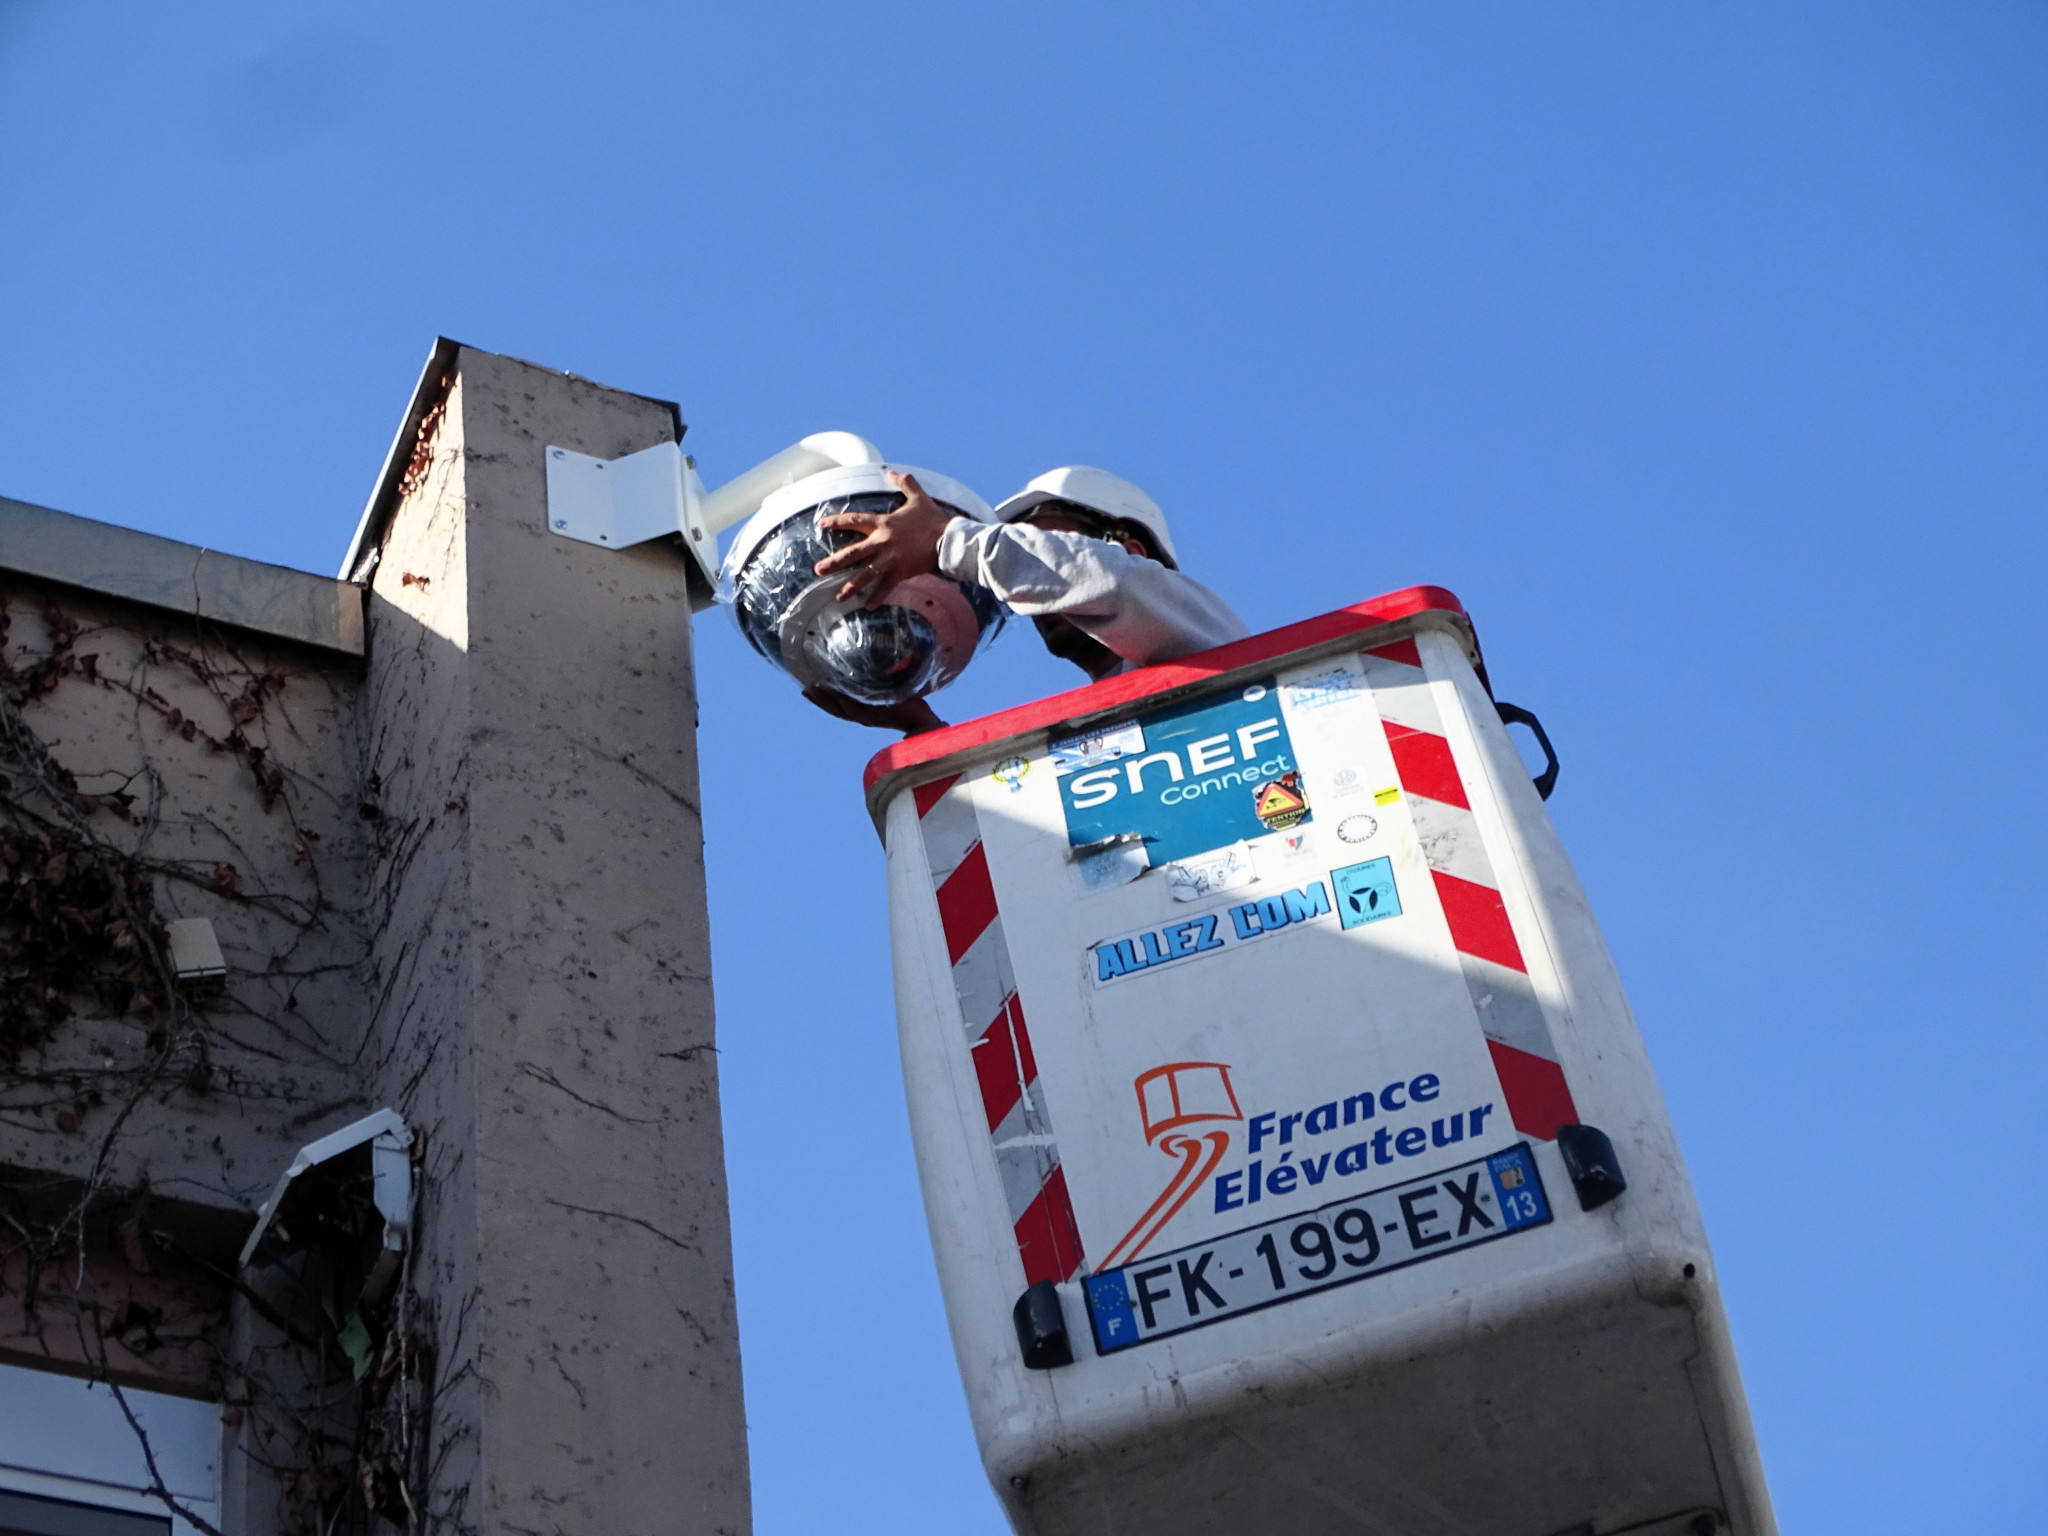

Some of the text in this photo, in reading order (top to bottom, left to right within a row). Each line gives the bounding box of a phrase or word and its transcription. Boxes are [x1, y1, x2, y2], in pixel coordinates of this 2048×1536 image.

[1160, 753, 1292, 805] Connect
[1095, 914, 1225, 982] ALLEZ
[1248, 1072, 1441, 1155] France
[1214, 1103, 1494, 1215] Elévateur
[1506, 1191, 1538, 1222] 13
[1133, 1171, 1496, 1330] FK-199-EX
[1107, 1317, 1122, 1337] F
